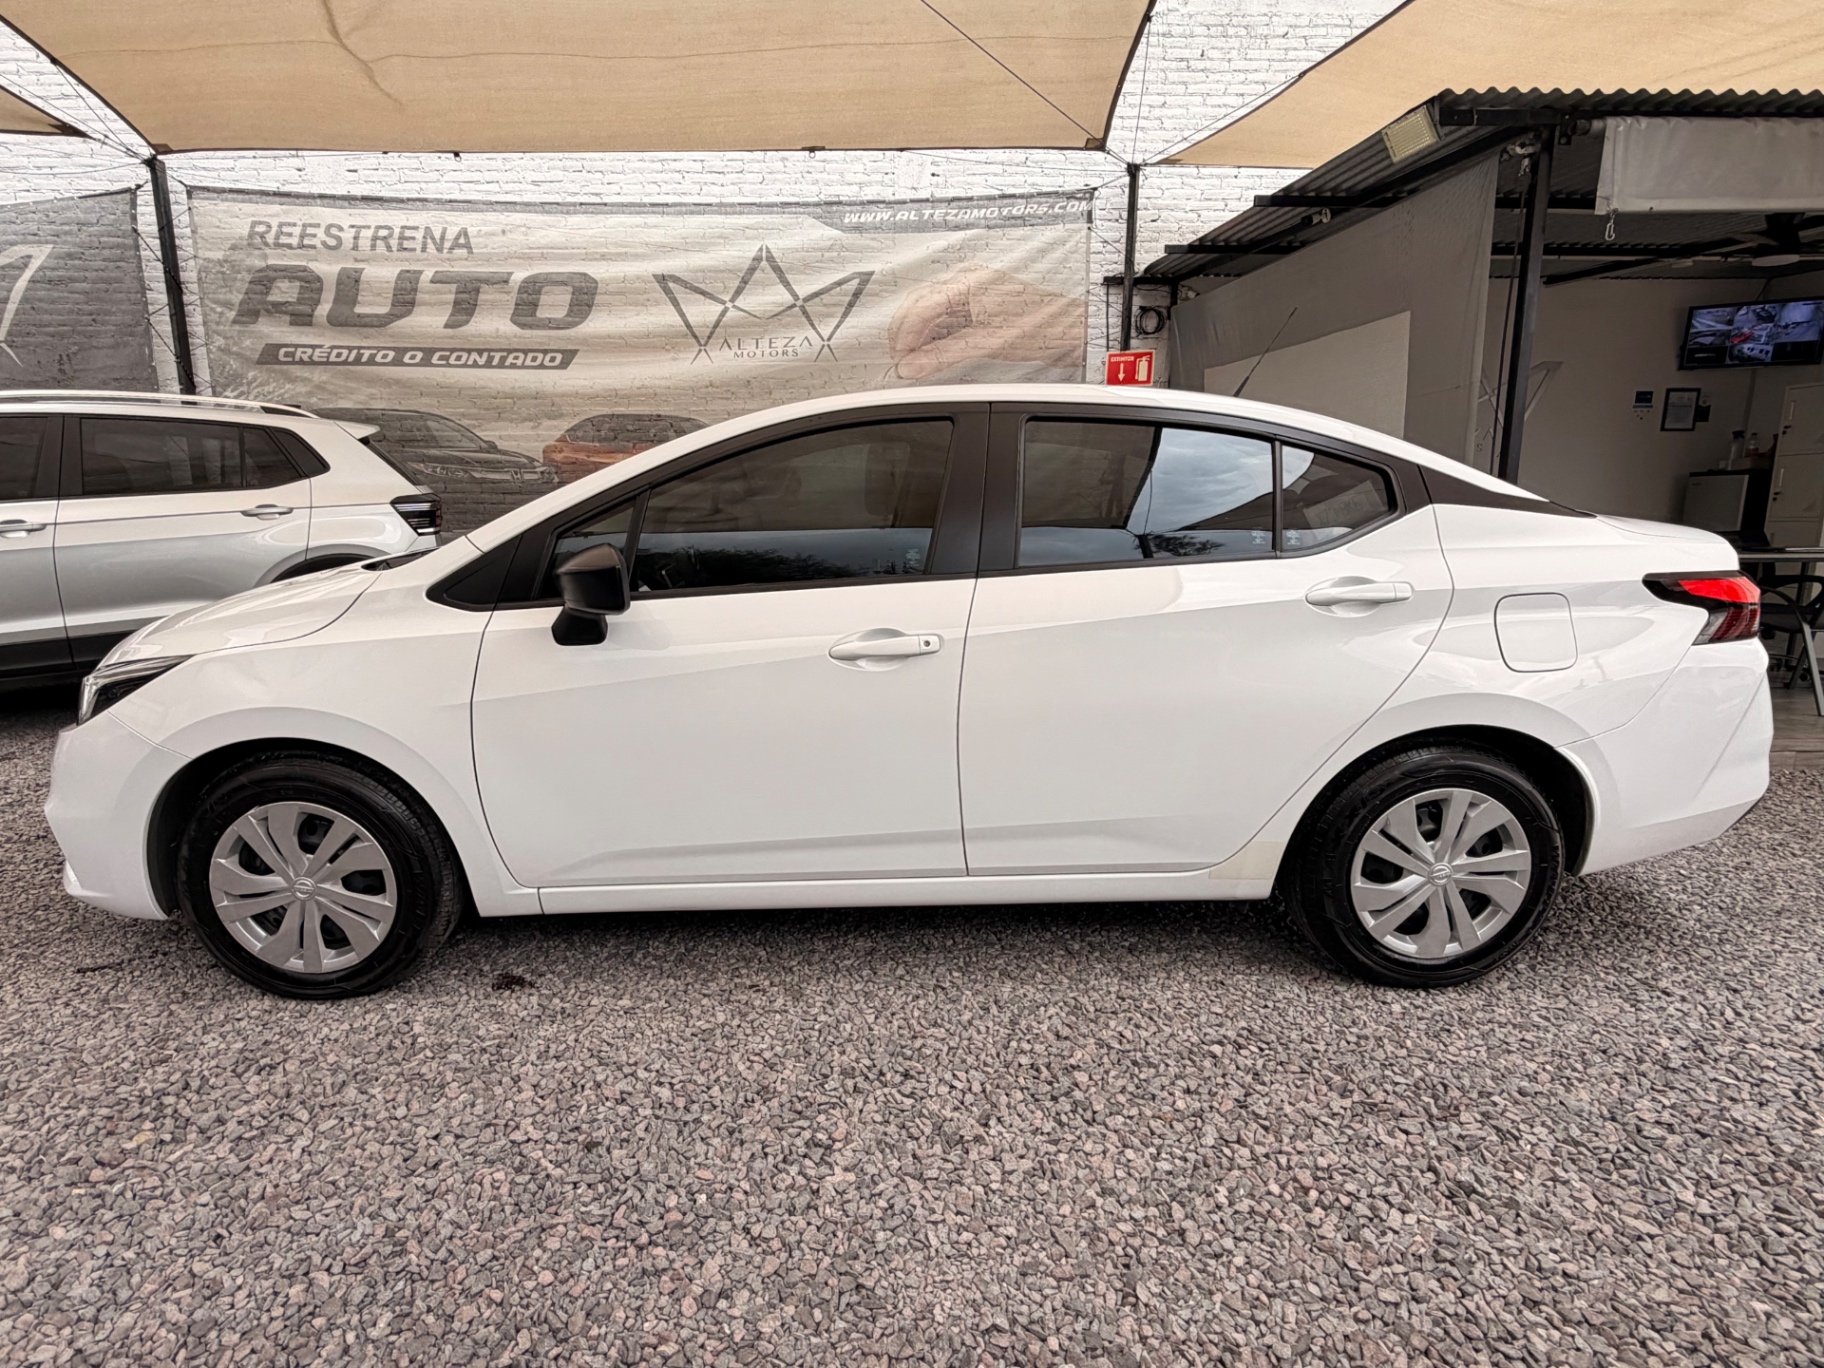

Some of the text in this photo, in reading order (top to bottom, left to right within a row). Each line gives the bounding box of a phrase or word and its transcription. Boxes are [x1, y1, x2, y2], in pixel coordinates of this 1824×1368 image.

[247, 219, 475, 255] REESTRENA
[231, 263, 599, 331] AUTO
[719, 336, 813, 351] ALTEZA
[733, 349, 799, 359] MOTORS
[277, 344, 563, 367] CRÉDITO O CONTADO
